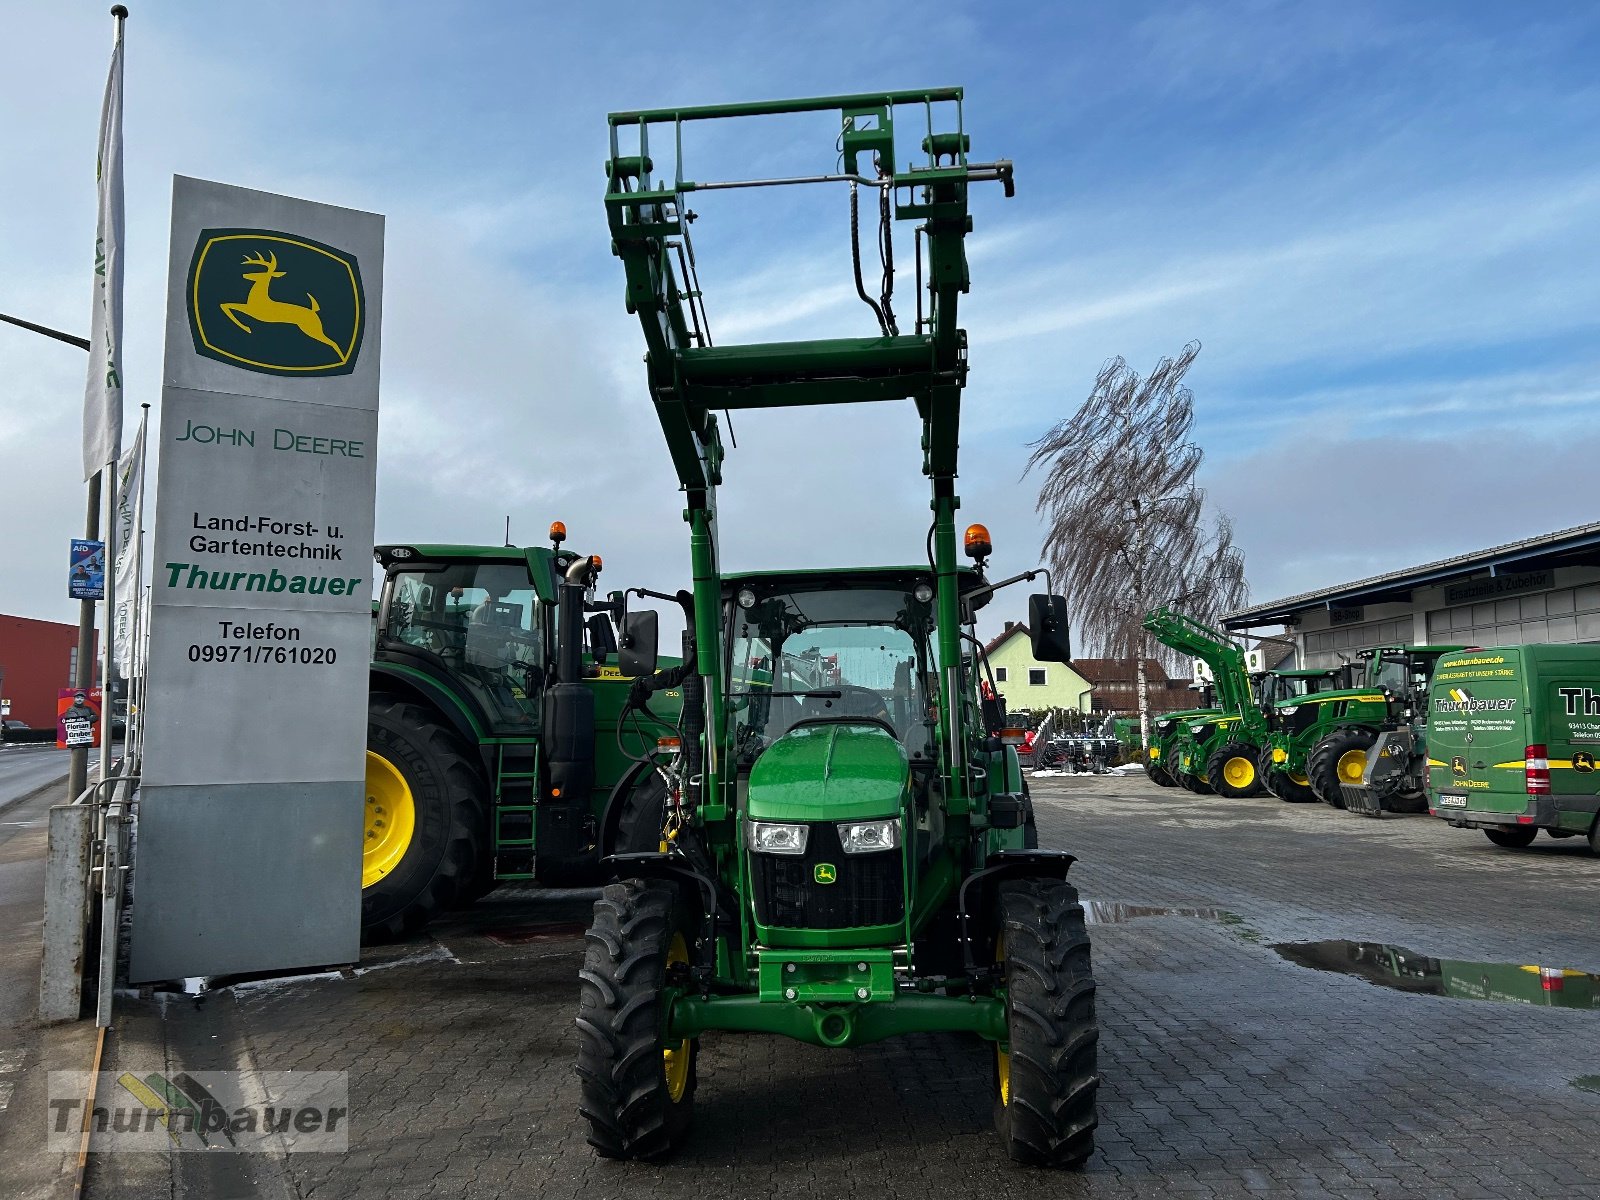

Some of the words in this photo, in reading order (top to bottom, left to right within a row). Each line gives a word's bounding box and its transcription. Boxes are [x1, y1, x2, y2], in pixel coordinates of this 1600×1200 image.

[175, 419, 255, 448] JOHN
[273, 428, 365, 459] DEERE
[193, 512, 318, 537] Land-Forst-
[327, 525, 344, 539] u.
[189, 535, 342, 561] Gartentechnik
[165, 562, 362, 596] Thurnbauer
[1449, 584, 1495, 600] Ersatzteile
[1496, 580, 1503, 592] &
[219, 621, 301, 641] Telefon
[188, 644, 337, 665] 09971/761020
[1443, 656, 1504, 668] www.thurnbauer.de
[1435, 697, 1517, 713] Thurnbauer
[1453, 779, 1468, 787] JOHN
[1468, 779, 1490, 788] DEERE
